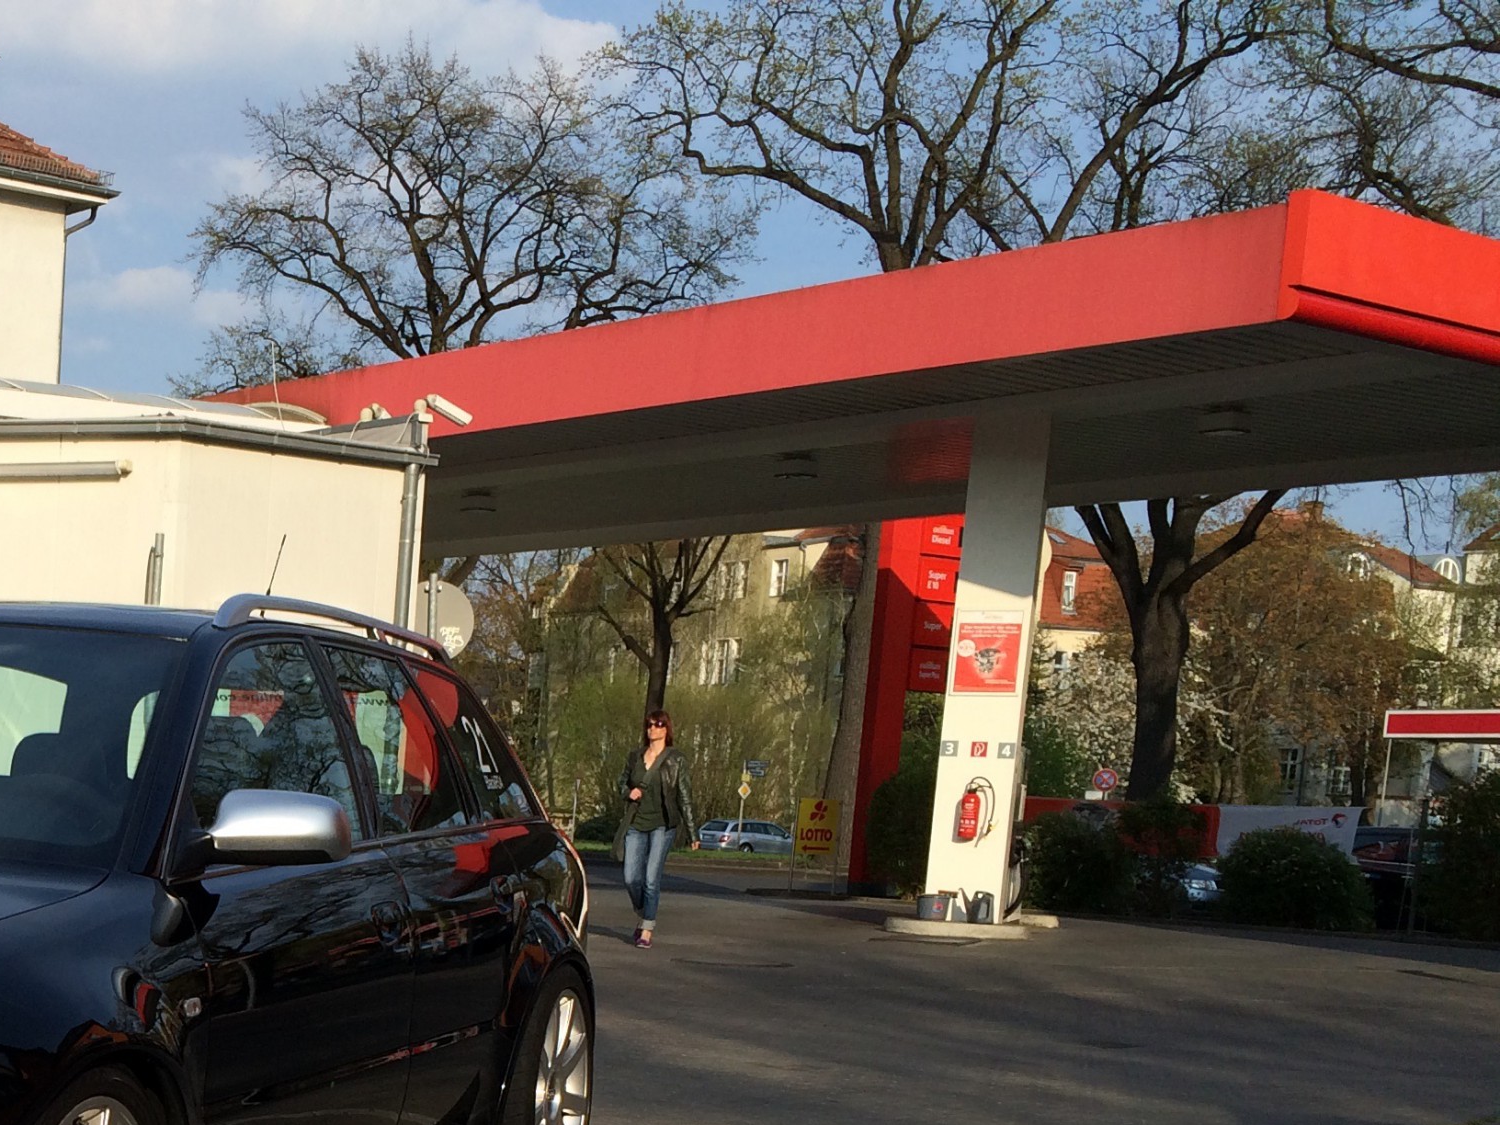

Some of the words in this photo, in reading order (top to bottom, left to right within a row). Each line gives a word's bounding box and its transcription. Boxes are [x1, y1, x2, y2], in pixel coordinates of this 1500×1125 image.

[928, 570, 947, 581] Super
[924, 620, 941, 631] Super
[461, 715, 499, 773] 21
[944, 742, 955, 755] 3
[1001, 744, 1011, 757] 4
[800, 827, 833, 842] LOTTO
